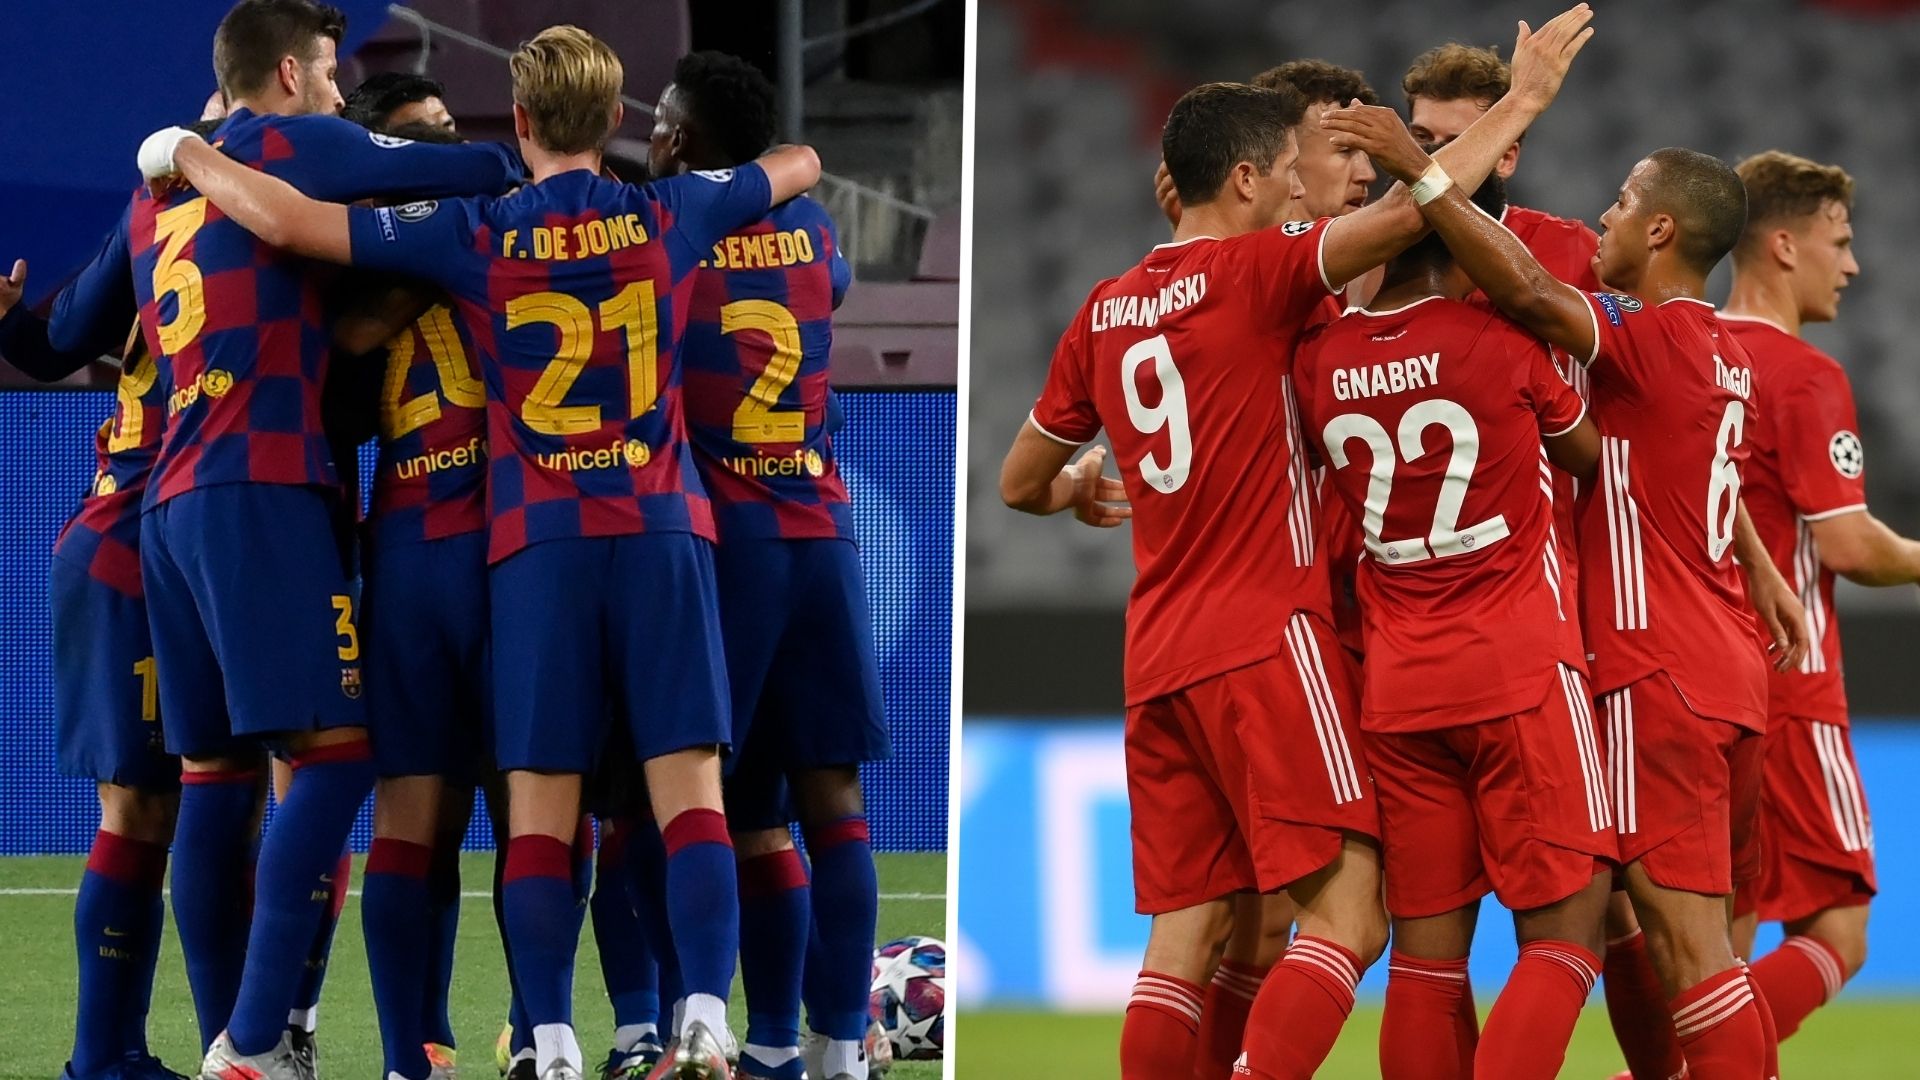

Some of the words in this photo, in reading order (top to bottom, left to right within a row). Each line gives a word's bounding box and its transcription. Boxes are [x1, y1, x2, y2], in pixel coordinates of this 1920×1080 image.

[503, 228, 528, 259] F.
[532, 226, 569, 260] DE
[571, 213, 650, 258] JONG
[712, 228, 814, 270] SEMEDO
[152, 196, 207, 357] 3
[1092, 272, 1208, 334] LEWANWSKI
[505, 279, 659, 436] 21
[720, 299, 806, 443] 2
[1332, 352, 1441, 402] GNABRY
[167, 373, 203, 418] nicef
[1121, 333, 1193, 495] 9
[396, 437, 479, 480] unicef
[537, 442, 622, 472] unicef
[722, 450, 804, 478] unicef
[1323, 398, 1511, 567] 22
[1707, 402, 1745, 562] 6
[331, 595, 359, 661] 3
[134, 656, 158, 721] 1
